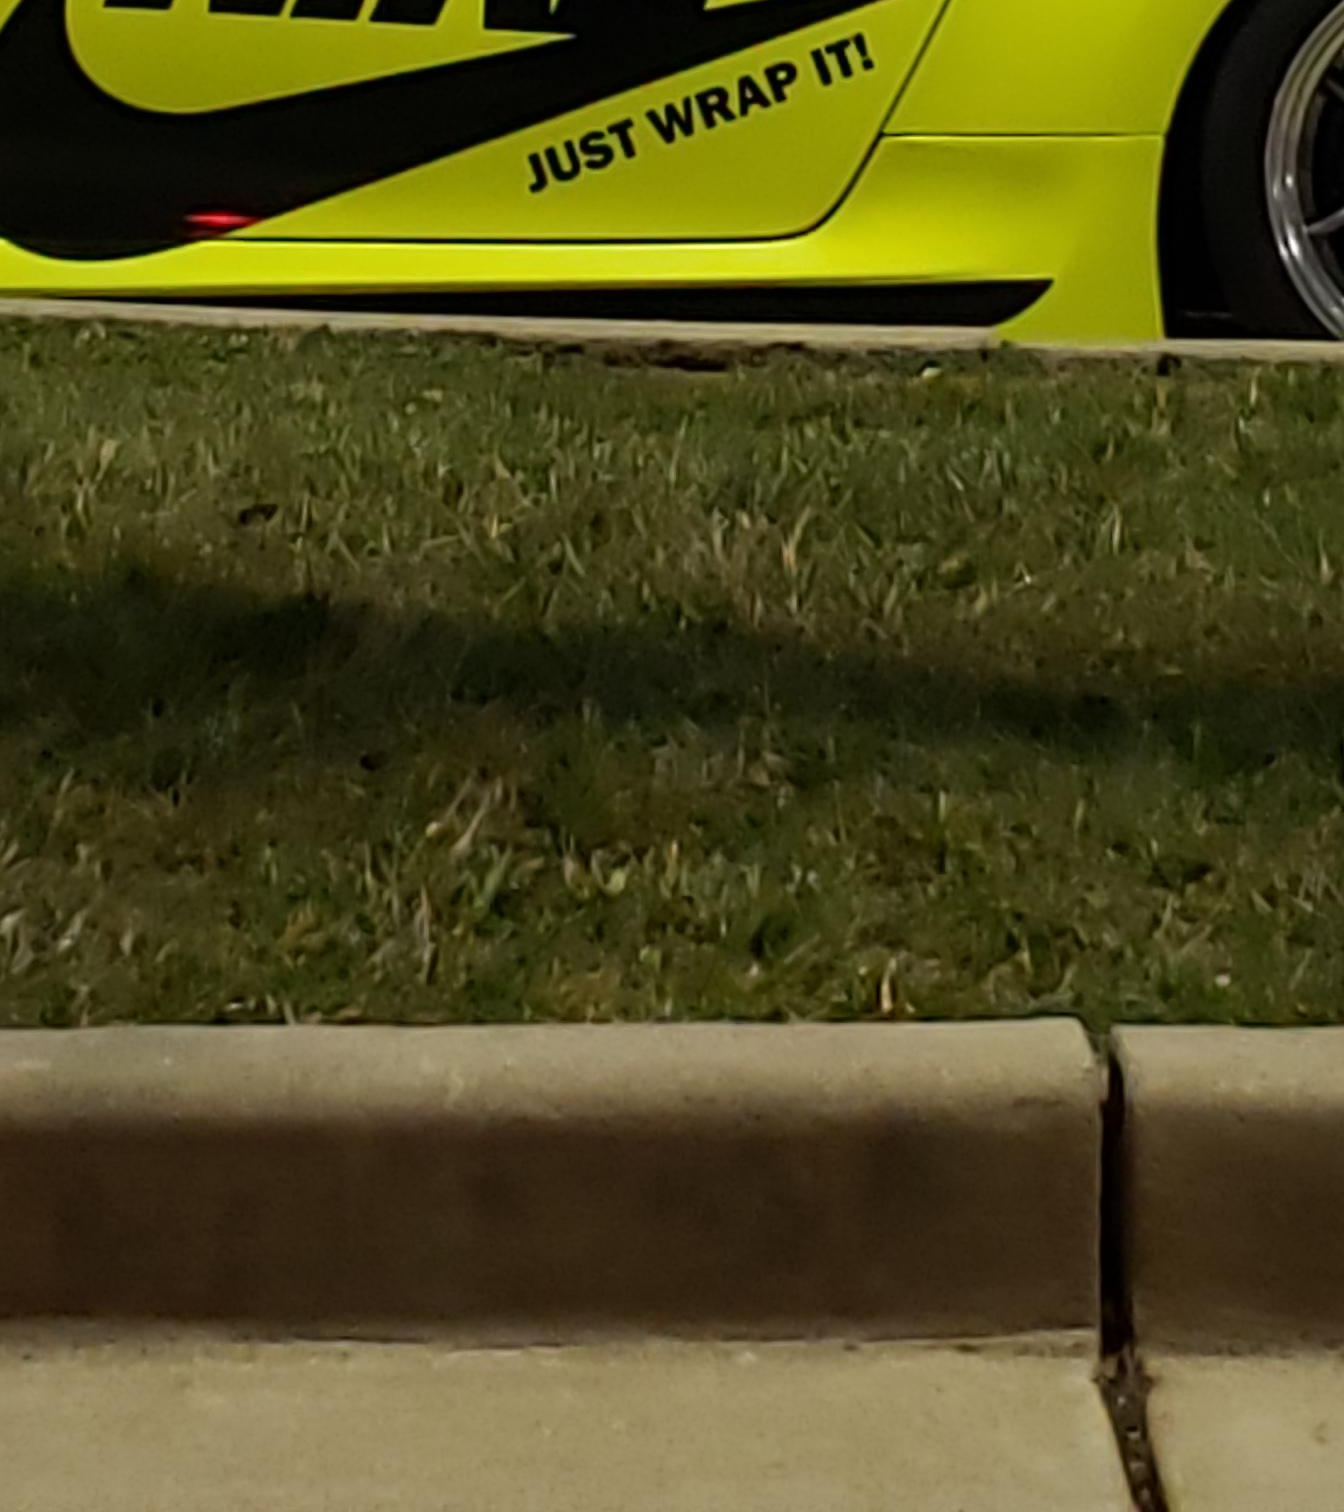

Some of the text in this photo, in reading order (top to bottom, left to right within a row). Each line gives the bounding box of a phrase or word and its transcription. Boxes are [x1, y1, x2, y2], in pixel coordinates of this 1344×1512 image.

[527, 32, 875, 194] JUST WRAP IT!
